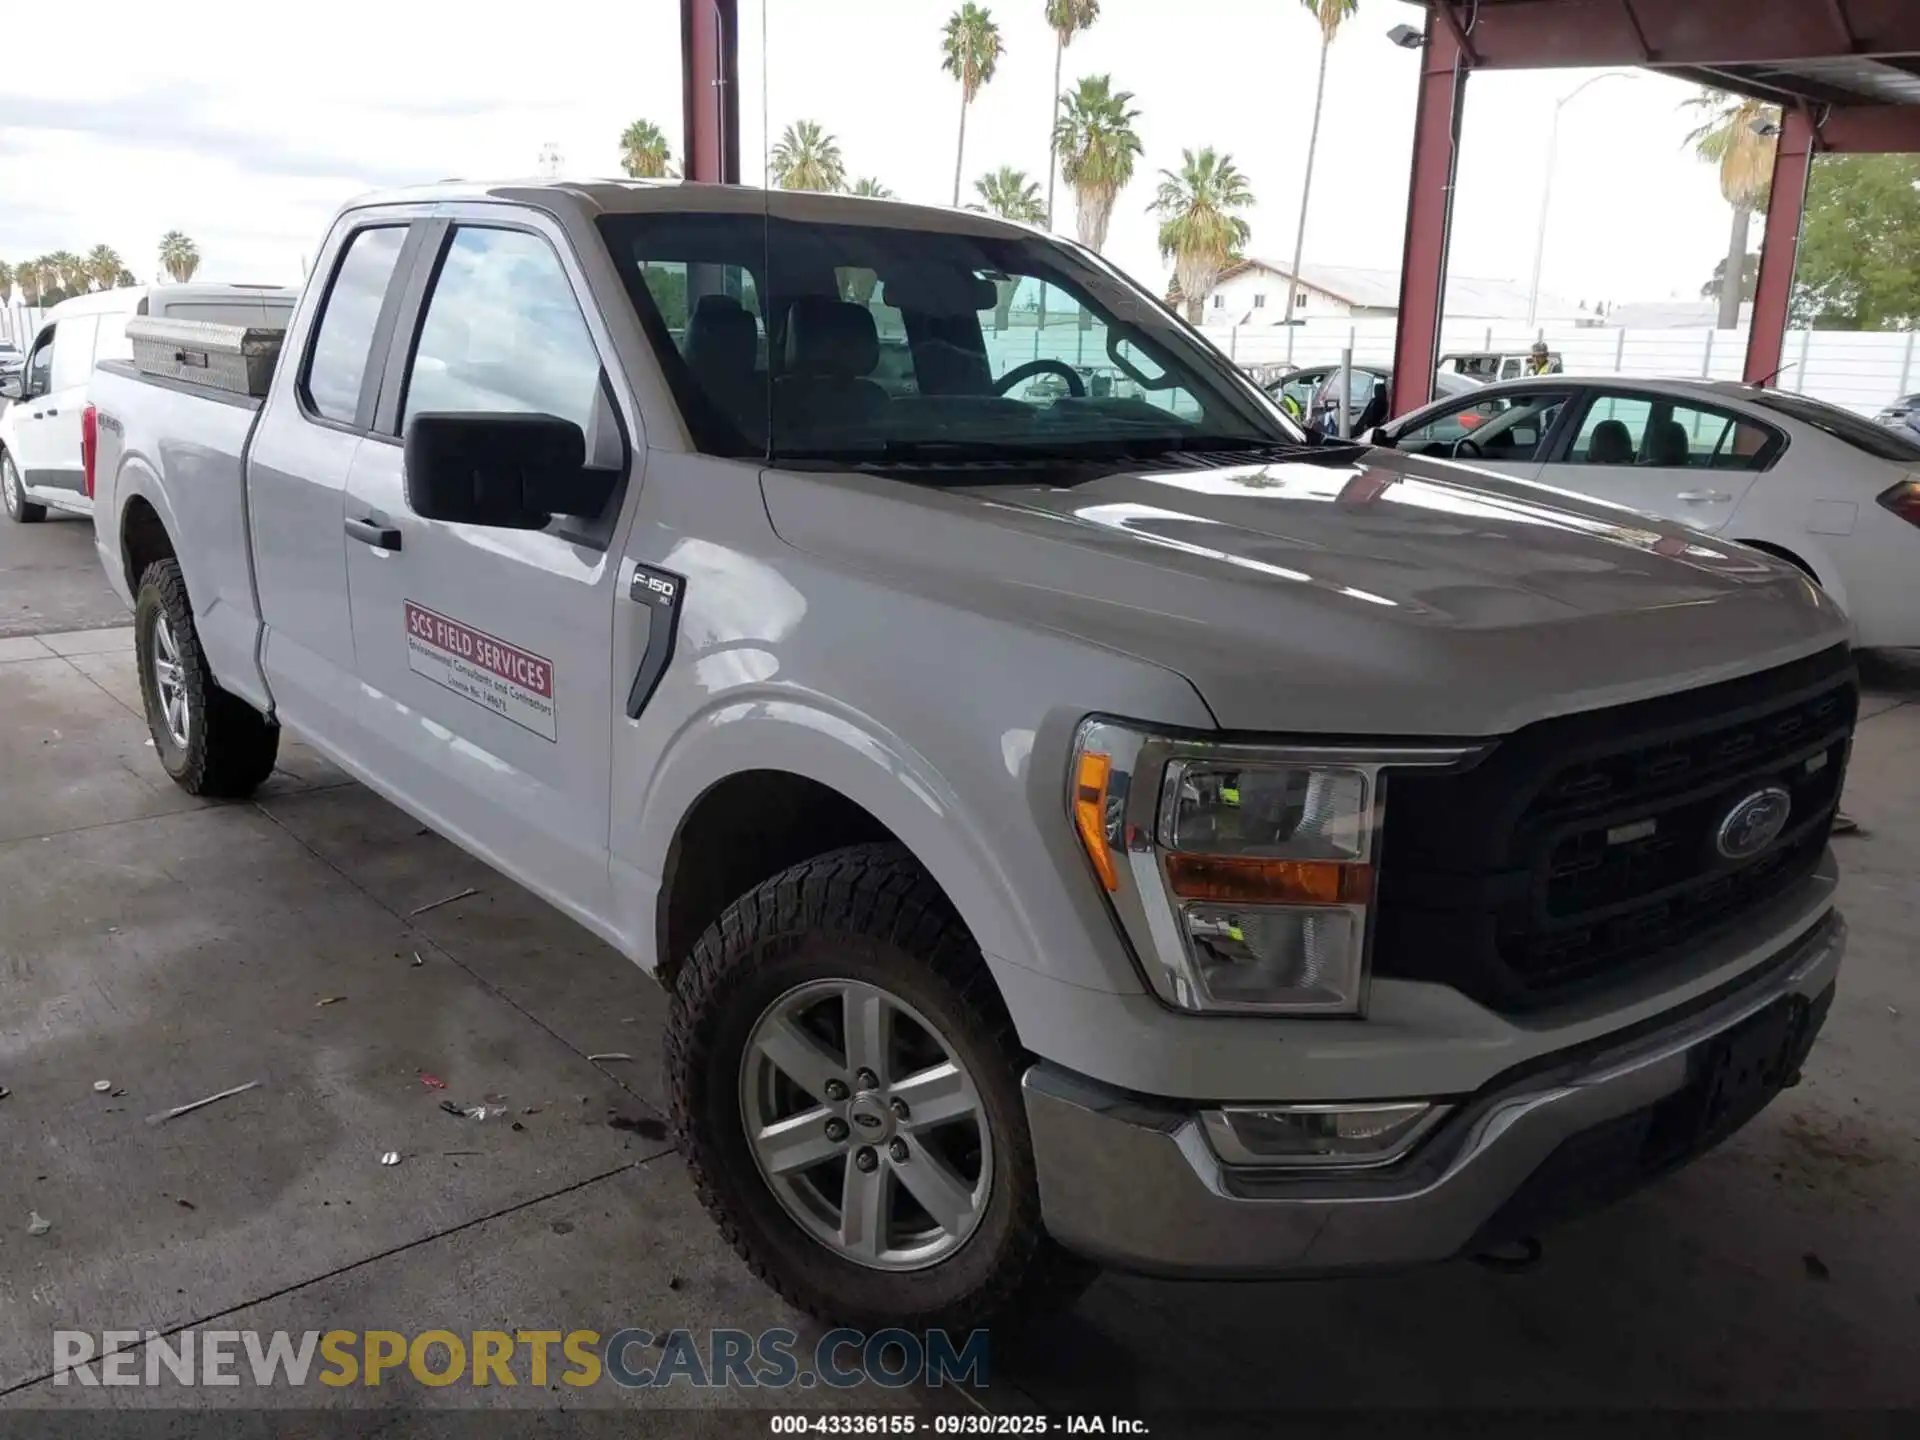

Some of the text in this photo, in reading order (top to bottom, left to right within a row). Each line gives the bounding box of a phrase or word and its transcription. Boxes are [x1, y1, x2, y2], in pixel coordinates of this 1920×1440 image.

[633, 573, 675, 596] F-150
[411, 610, 545, 691] SCS FIELD SERVICES
